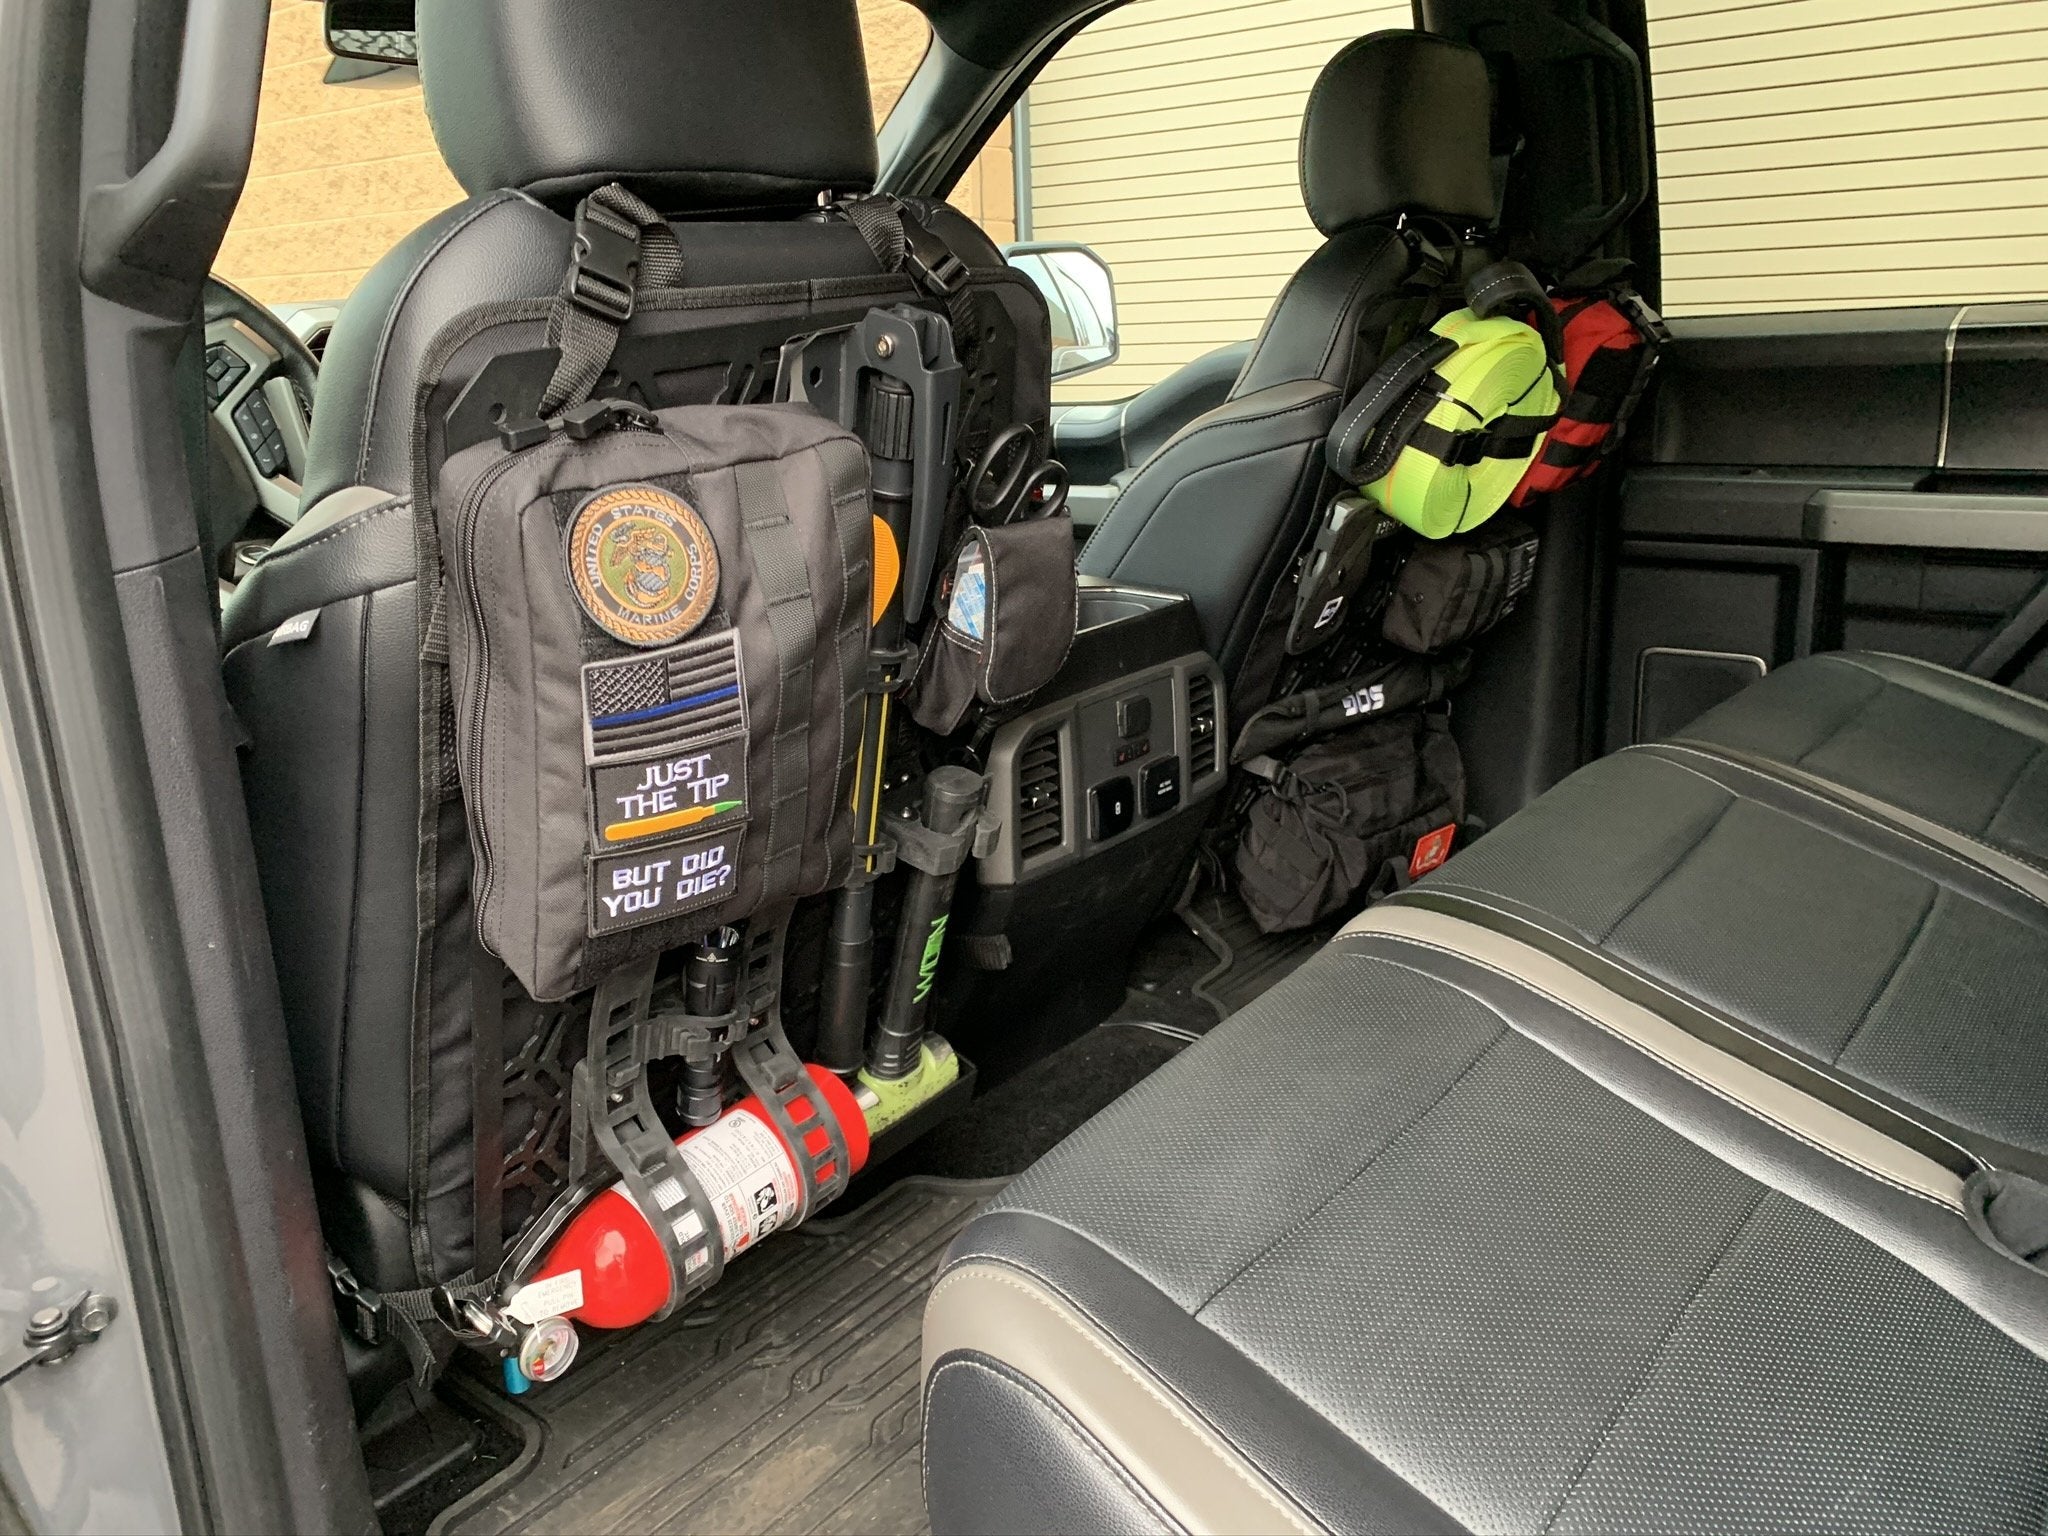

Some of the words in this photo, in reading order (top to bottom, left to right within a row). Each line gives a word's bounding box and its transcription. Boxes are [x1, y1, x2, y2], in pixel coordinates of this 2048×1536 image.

[586, 523, 603, 588] UNITED
[611, 505, 677, 528] STATES
[617, 606, 682, 626] MARINE
[684, 543, 702, 600] CORPS
[637, 754, 711, 790] JUST
[617, 787, 677, 819] THE
[687, 774, 729, 803] TIP
[602, 887, 662, 917] YOU
[676, 865, 731, 900] DIE?
[612, 860, 671, 890] BUT
[682, 845, 725, 875] DID
